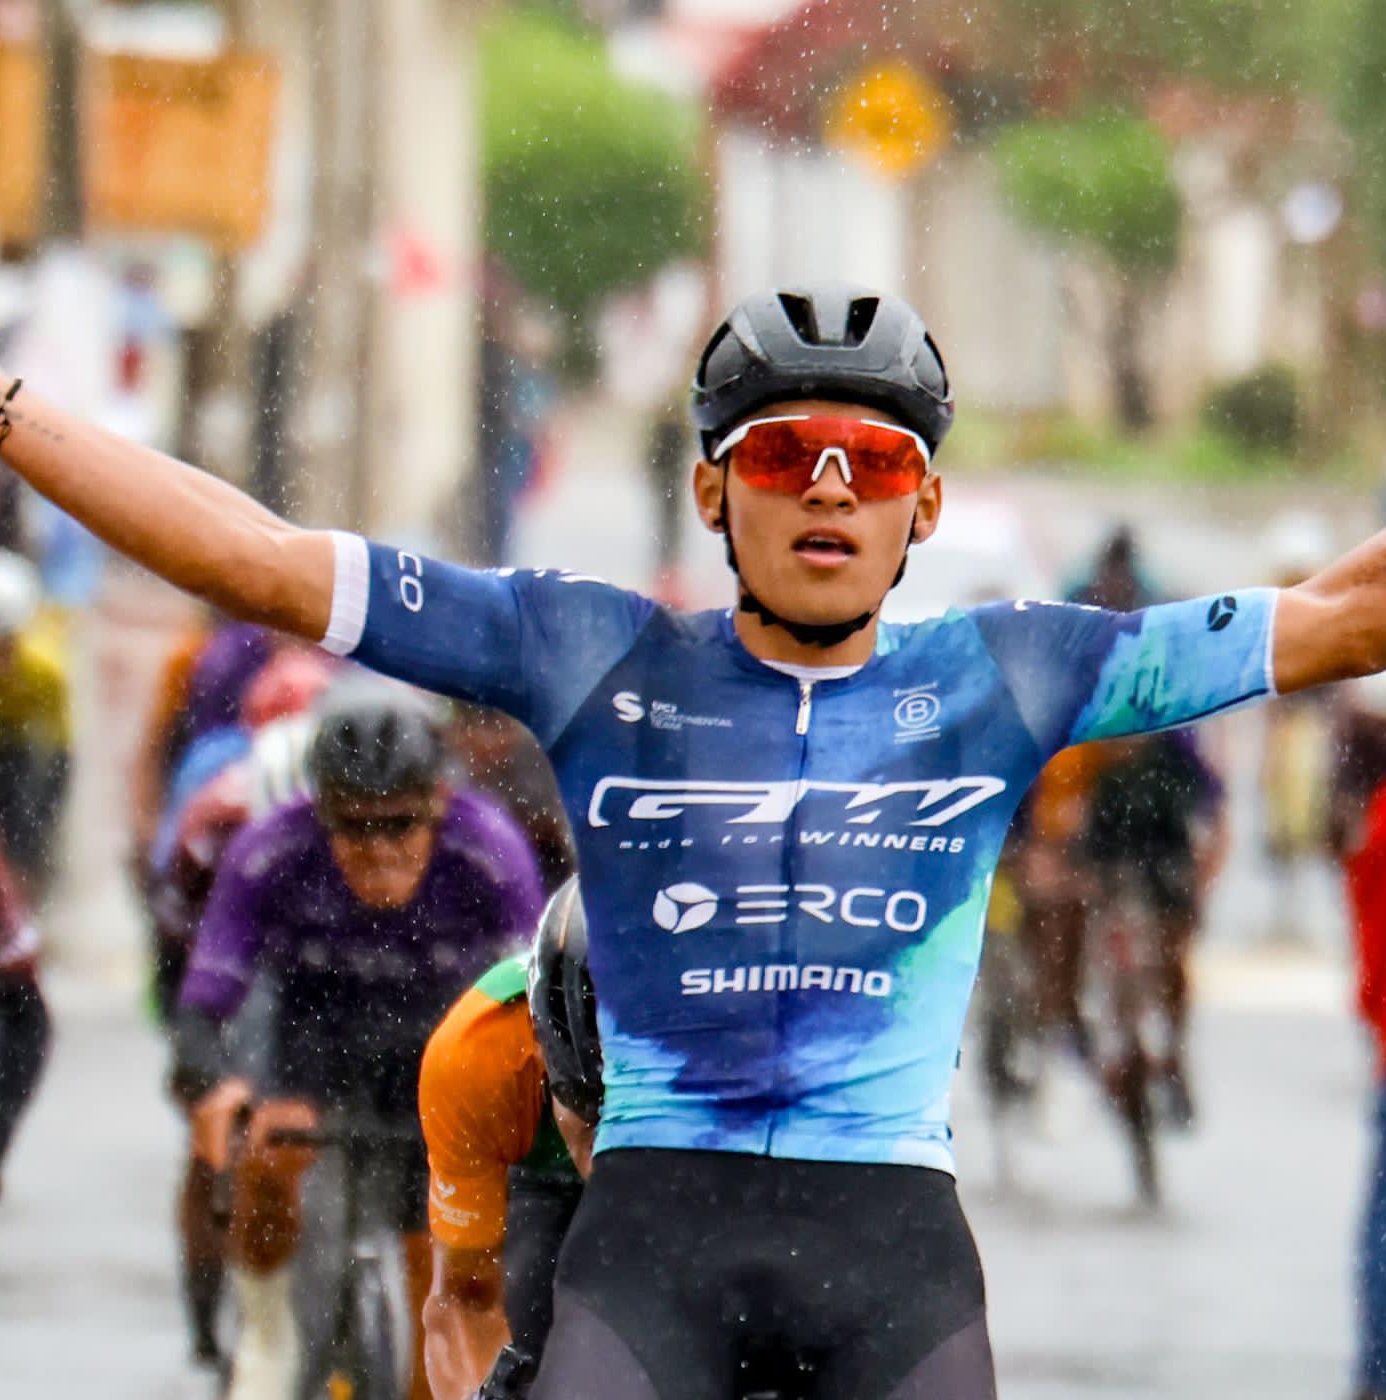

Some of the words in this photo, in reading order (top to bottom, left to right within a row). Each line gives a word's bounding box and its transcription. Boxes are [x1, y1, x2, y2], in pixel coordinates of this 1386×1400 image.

[650, 711, 734, 728] CONTINENTAL
[618, 838, 694, 851] made
[721, 834, 784, 846] for
[799, 830, 967, 854] WINNERS
[735, 884, 929, 933] ERCO
[680, 964, 892, 998] SHIMANO
